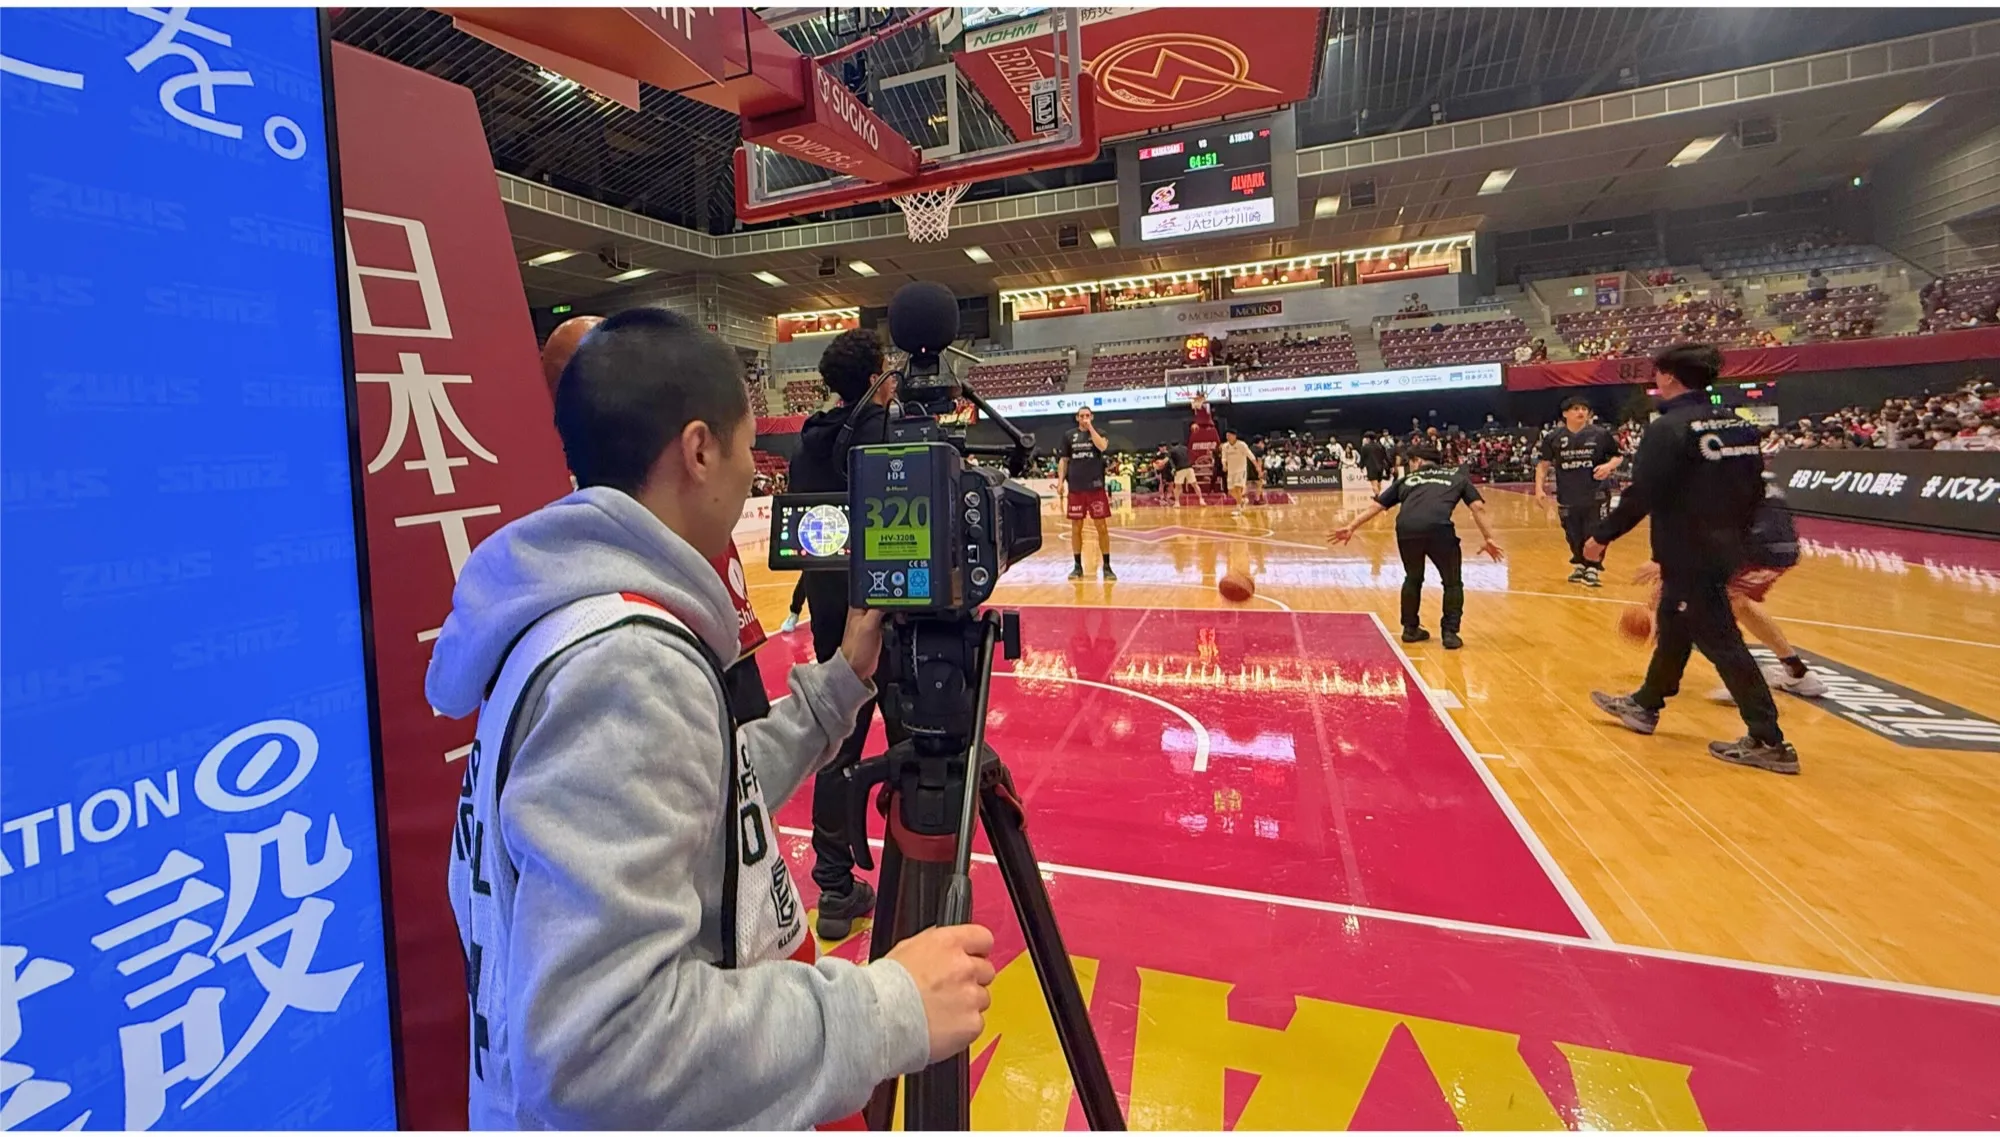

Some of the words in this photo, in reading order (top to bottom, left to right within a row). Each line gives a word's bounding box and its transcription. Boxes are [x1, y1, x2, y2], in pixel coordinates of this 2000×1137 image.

[973, 22, 1038, 47] NOHMI
[832, 84, 879, 151] SUGIKO
[1300, 475, 1339, 485] SoftBank
[1789, 469, 1908, 497] #Bリーグ10周年
[1920, 475, 2000, 503] #バスケ
[865, 496, 930, 528] 320
